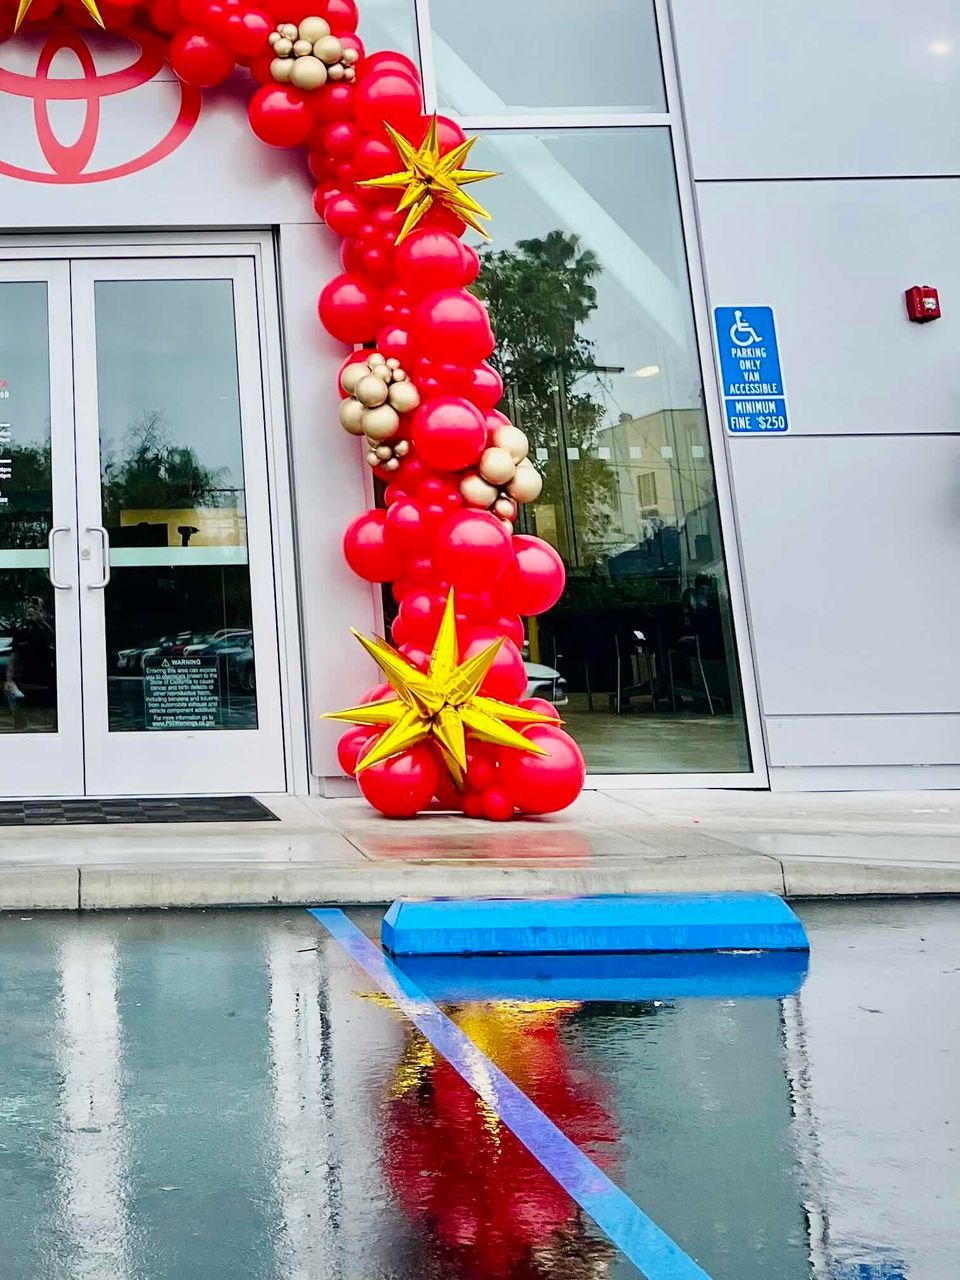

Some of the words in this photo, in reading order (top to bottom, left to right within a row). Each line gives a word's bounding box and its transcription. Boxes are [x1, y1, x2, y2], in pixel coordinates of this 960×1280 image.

[731, 348, 766, 358] PARKING
[740, 360, 760, 370] ONLY
[744, 372, 760, 382] VAN
[730, 384, 778, 394] ACCESSIBLE
[735, 401, 776, 414] MINIMUM
[730, 416, 752, 429] FINE
[758, 416, 785, 430] $250
